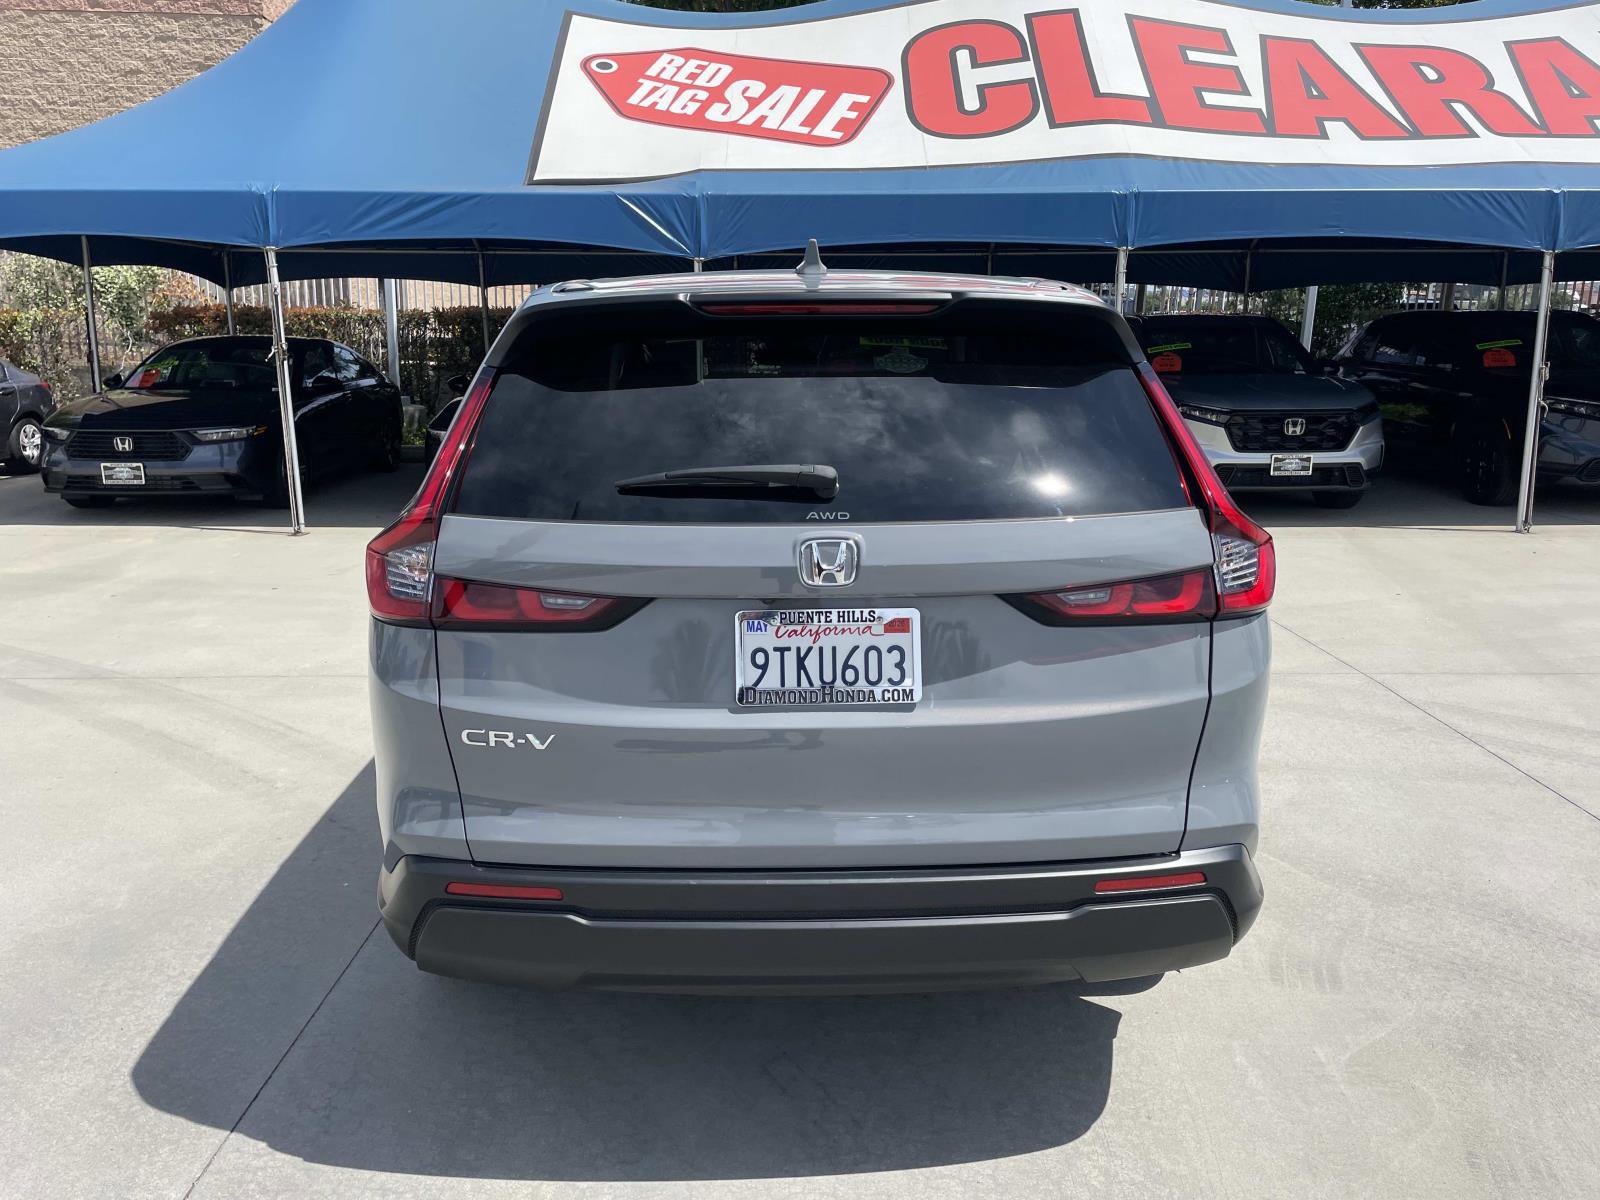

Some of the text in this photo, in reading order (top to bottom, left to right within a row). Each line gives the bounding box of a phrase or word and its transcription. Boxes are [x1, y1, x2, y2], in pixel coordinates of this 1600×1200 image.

[645, 53, 733, 88] RED
[626, 78, 709, 115] TAG
[705, 79, 871, 139] SALE
[746, 620, 768, 633] MAY
[779, 610, 876, 624] PUENTE HILLS
[775, 624, 884, 645] California
[750, 645, 906, 687] 9TKU603
[461, 729, 556, 750] CR-V
